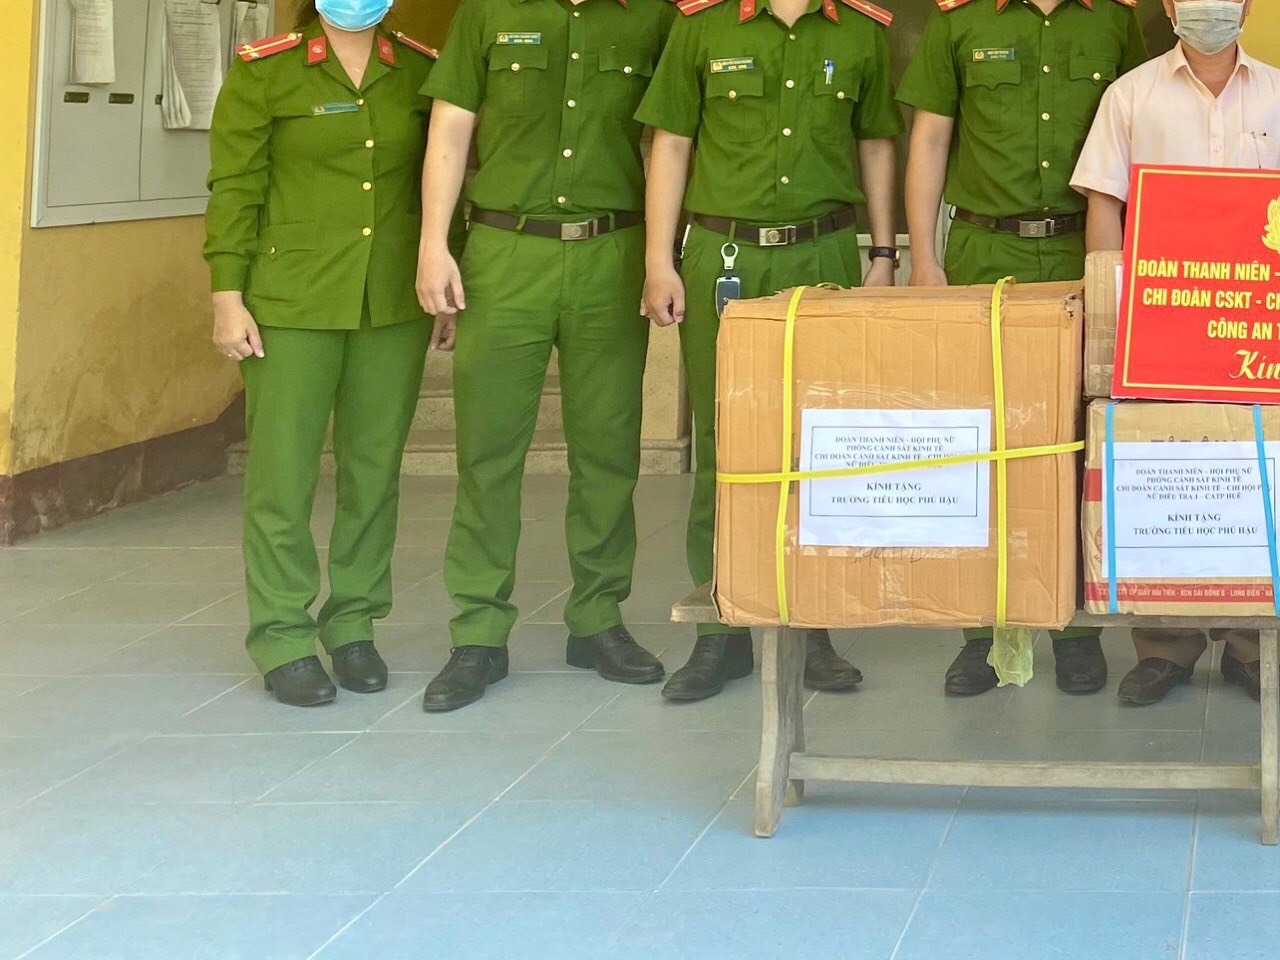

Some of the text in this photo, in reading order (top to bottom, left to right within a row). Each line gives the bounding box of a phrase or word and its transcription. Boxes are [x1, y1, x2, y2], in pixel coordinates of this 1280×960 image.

[1138, 257, 1178, 277] ĐOÀN
[1182, 261, 1230, 280] THANH
[1234, 260, 1271, 281] NIÊN
[1143, 287, 1167, 305] CHI
[1171, 286, 1212, 307] ĐOÀN
[1215, 290, 1252, 309] CSKT
[1207, 317, 1248, 339] CÔNG
[1251, 322, 1272, 340] AN
